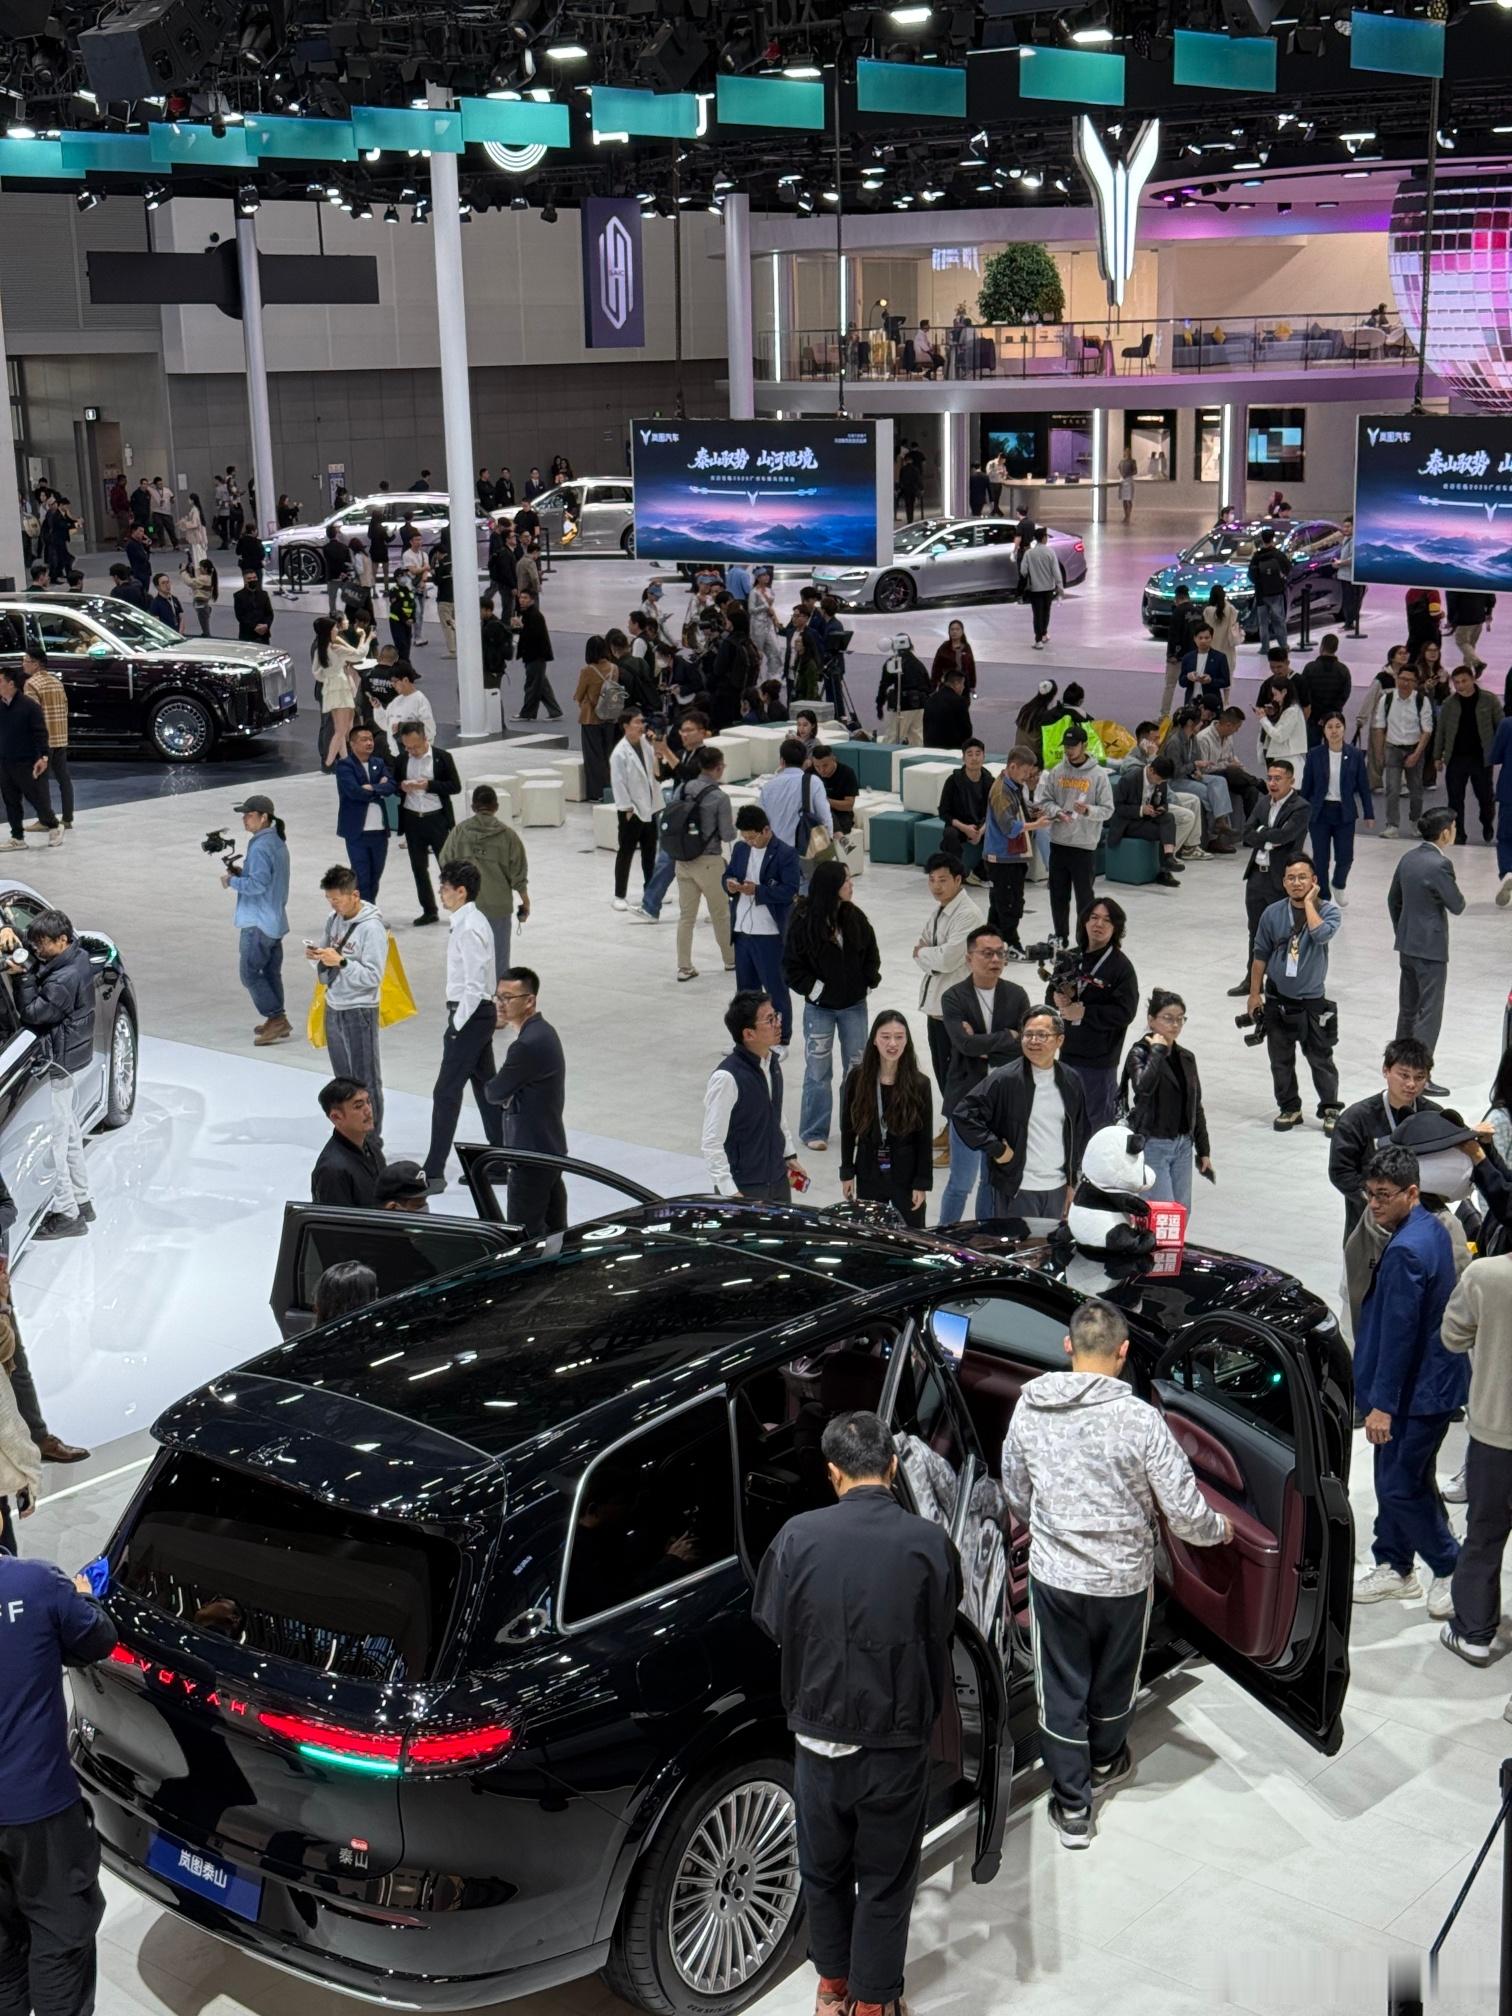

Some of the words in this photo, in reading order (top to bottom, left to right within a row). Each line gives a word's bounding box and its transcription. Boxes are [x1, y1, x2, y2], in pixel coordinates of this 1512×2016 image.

[138, 1658, 248, 1716] VOYAH
[178, 1848, 228, 1889] 岚图泰山
[339, 1848, 368, 1870] 泰山
